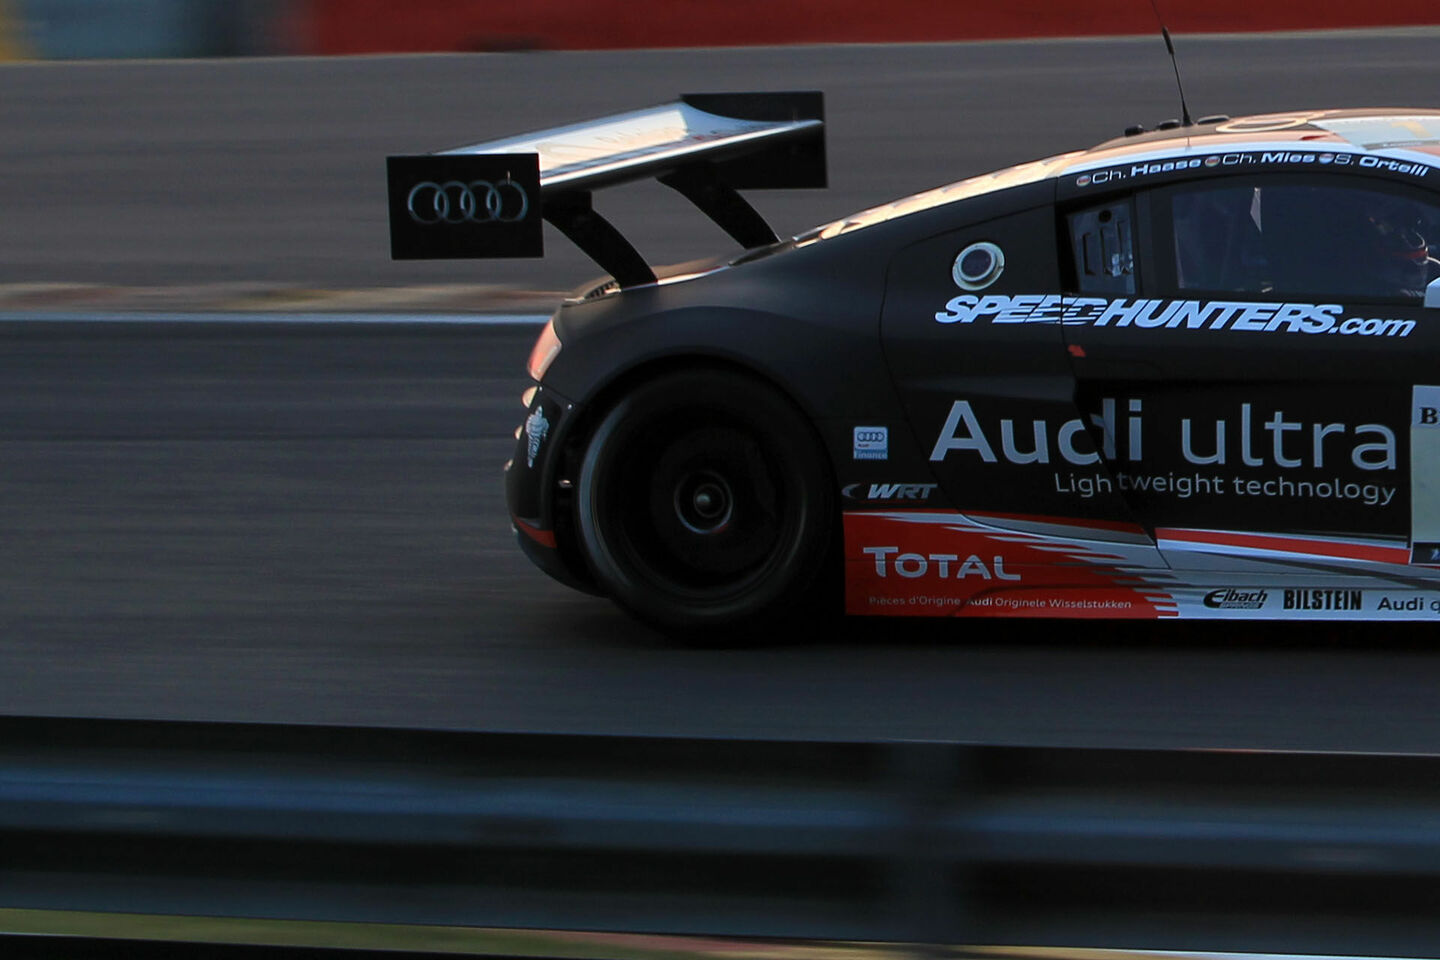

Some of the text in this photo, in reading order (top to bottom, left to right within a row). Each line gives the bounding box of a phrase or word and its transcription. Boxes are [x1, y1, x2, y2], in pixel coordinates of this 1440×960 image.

[1092, 158, 1201, 184] Ch. Haase
[1222, 152, 1316, 166] Ch. Mies
[1334, 153, 1430, 177] S. Ortelli
[934, 294, 1417, 337] SPEEDHUNTERS.com
[929, 397, 1398, 471] Audi ultra
[867, 483, 938, 499] WRT
[1054, 472, 1397, 506] Lightweight technology
[863, 546, 1022, 581] TOTAL
[908, 596, 961, 608] d'Origine
[995, 598, 1046, 609] Originele
[1049, 599, 1132, 610] Wisselstukken
[1283, 590, 1362, 610] BILSTEIN
[1377, 597, 1424, 612] Audi
